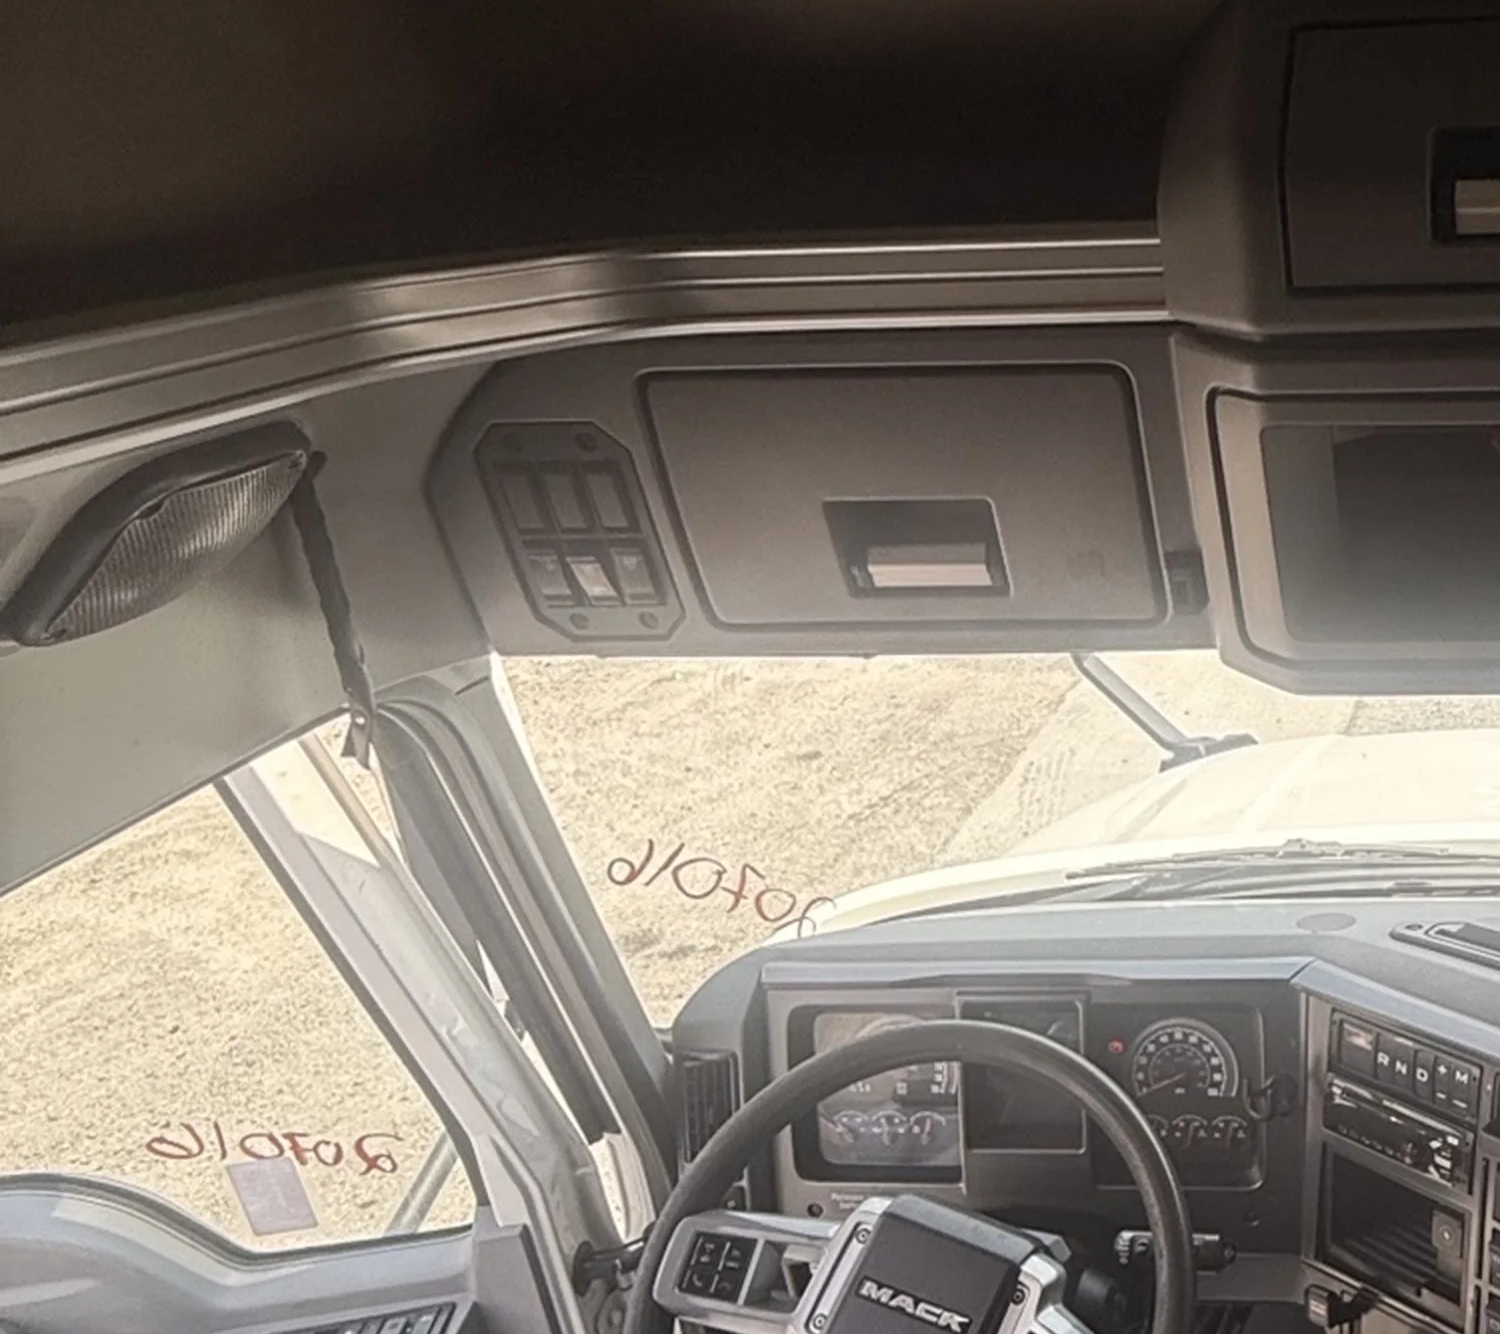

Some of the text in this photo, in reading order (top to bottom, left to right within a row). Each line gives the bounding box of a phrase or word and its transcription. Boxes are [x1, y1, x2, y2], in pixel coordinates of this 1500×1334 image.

[1377, 1052, 1468, 1085] R N D M
[859, 1280, 970, 1333] MACK
